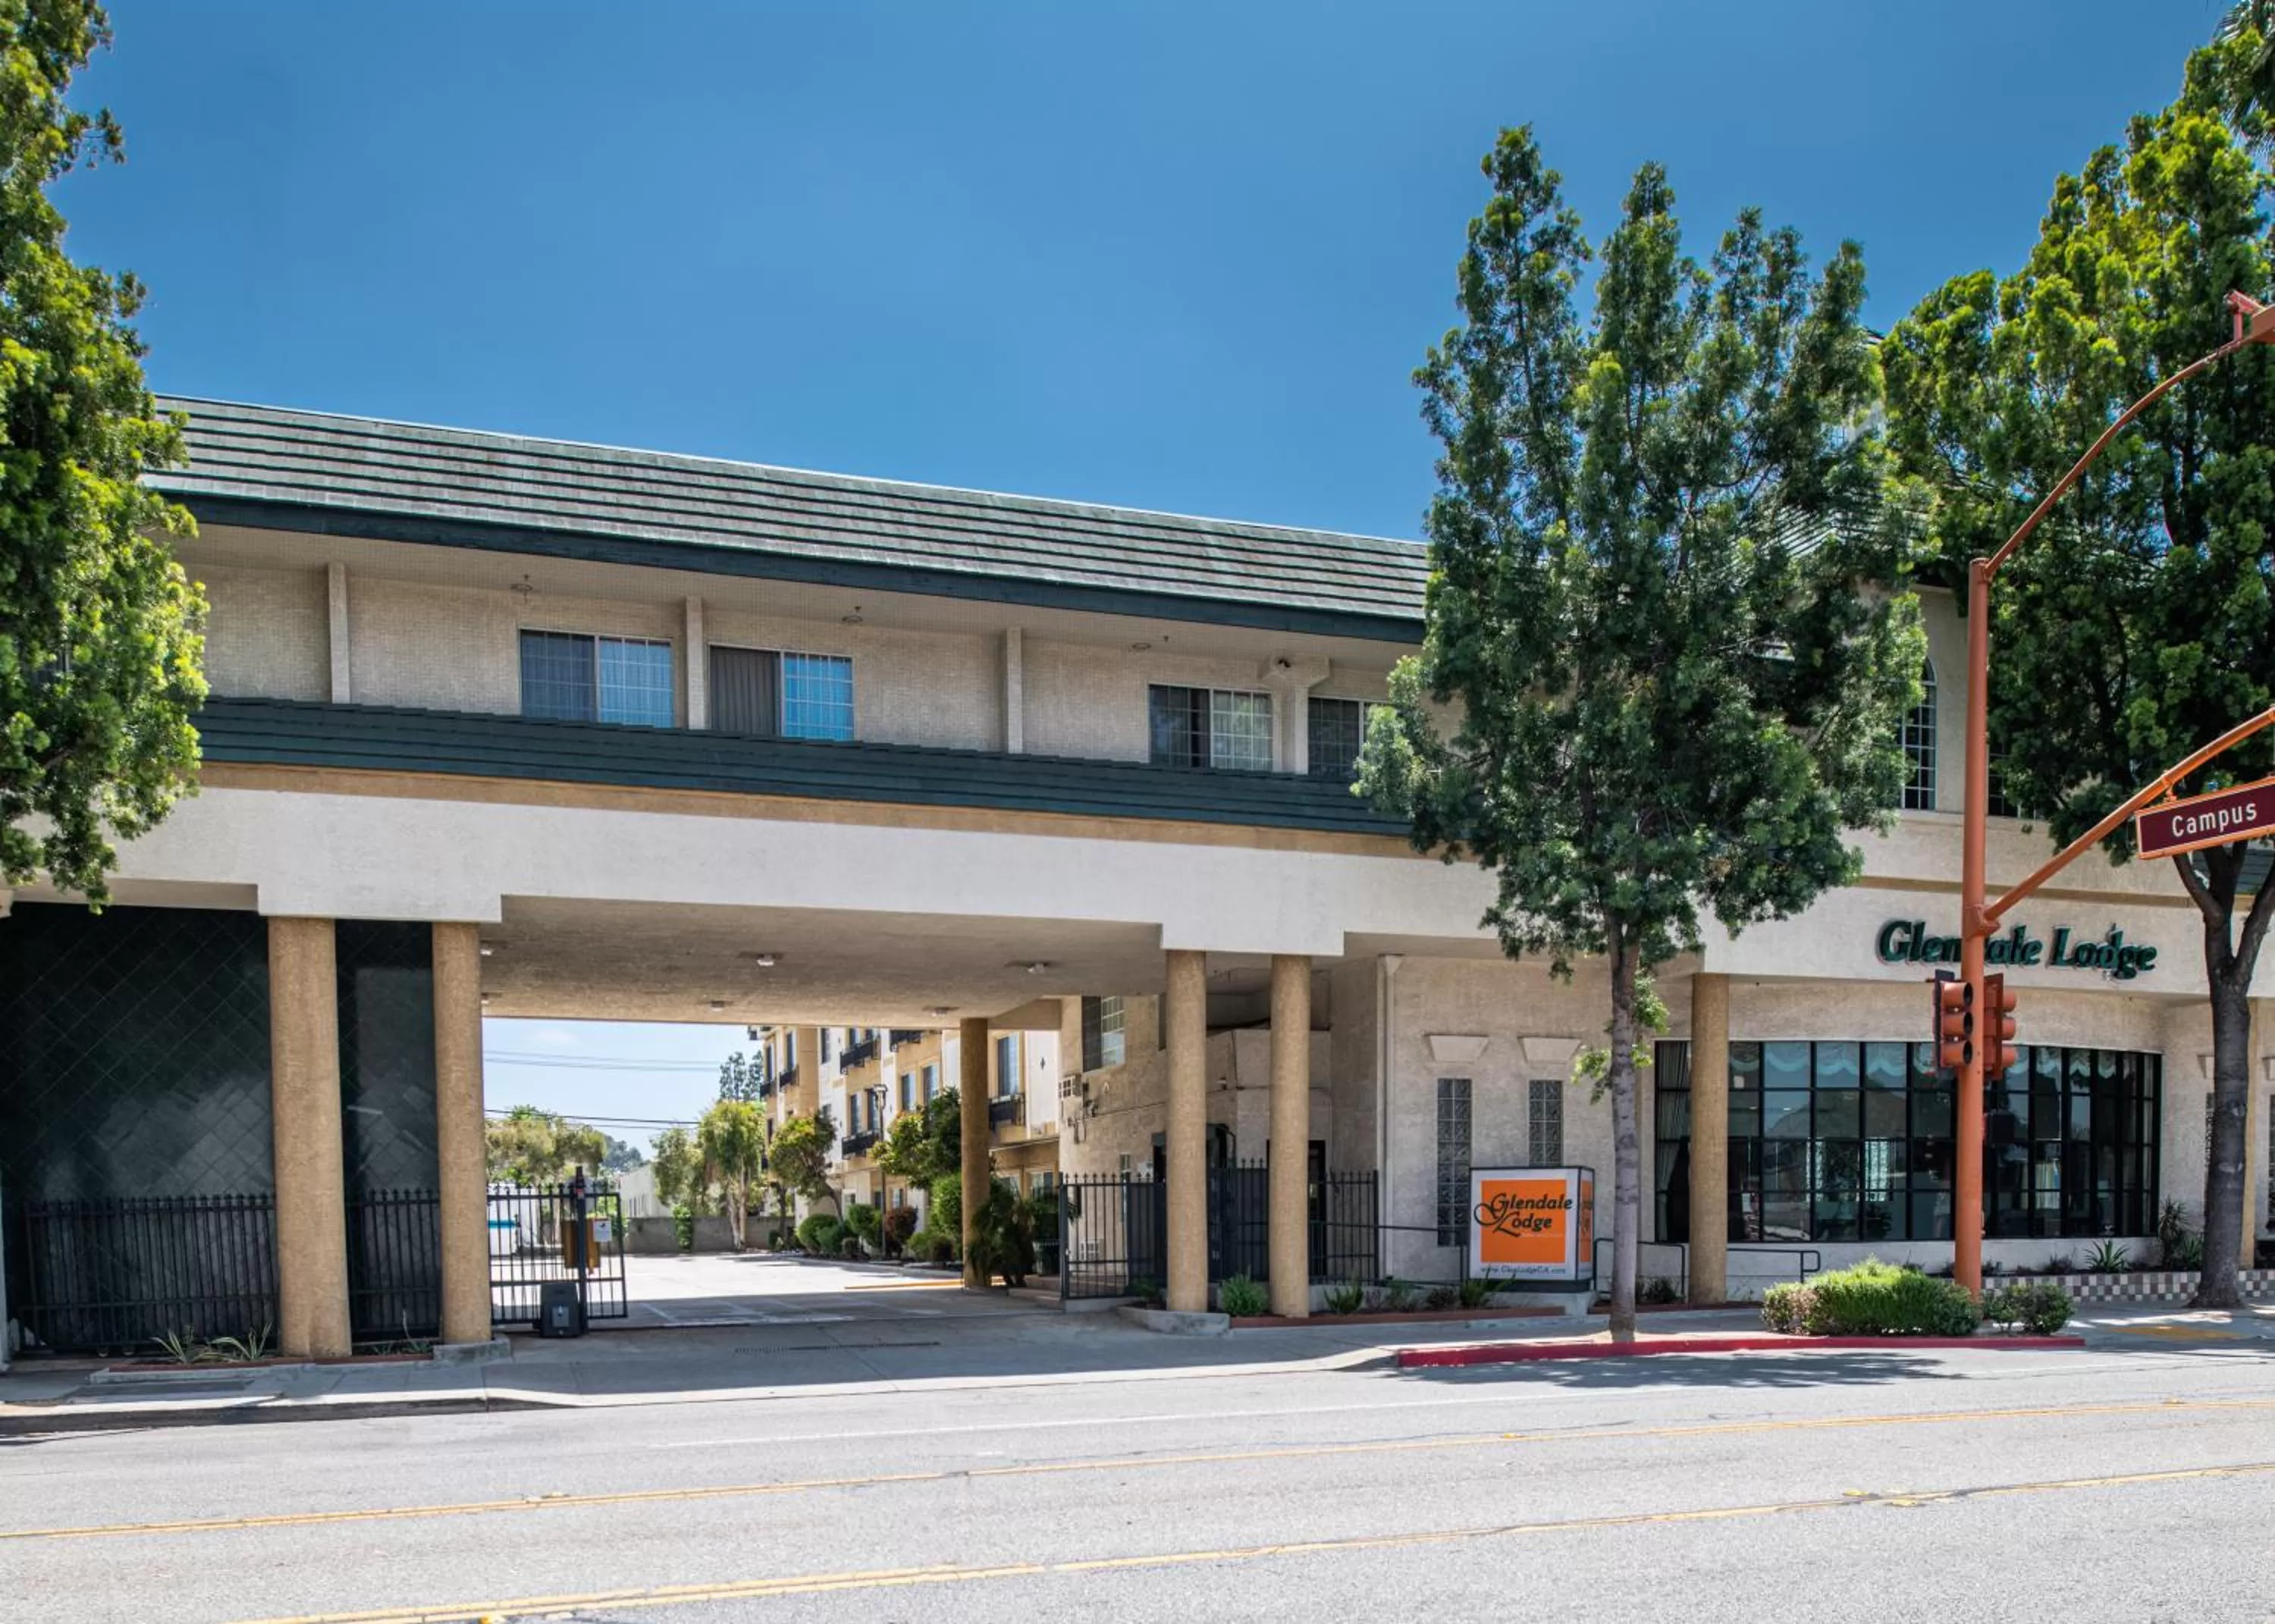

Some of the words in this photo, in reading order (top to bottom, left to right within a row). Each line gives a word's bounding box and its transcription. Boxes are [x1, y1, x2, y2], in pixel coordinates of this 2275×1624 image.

[2172, 803, 2257, 838] Campus
[1878, 919, 2044, 965] Glenale
[2048, 924, 2157, 980] Lodge
[1473, 1193, 1573, 1226] Glendale
[1492, 1211, 1552, 1237] Lodge
